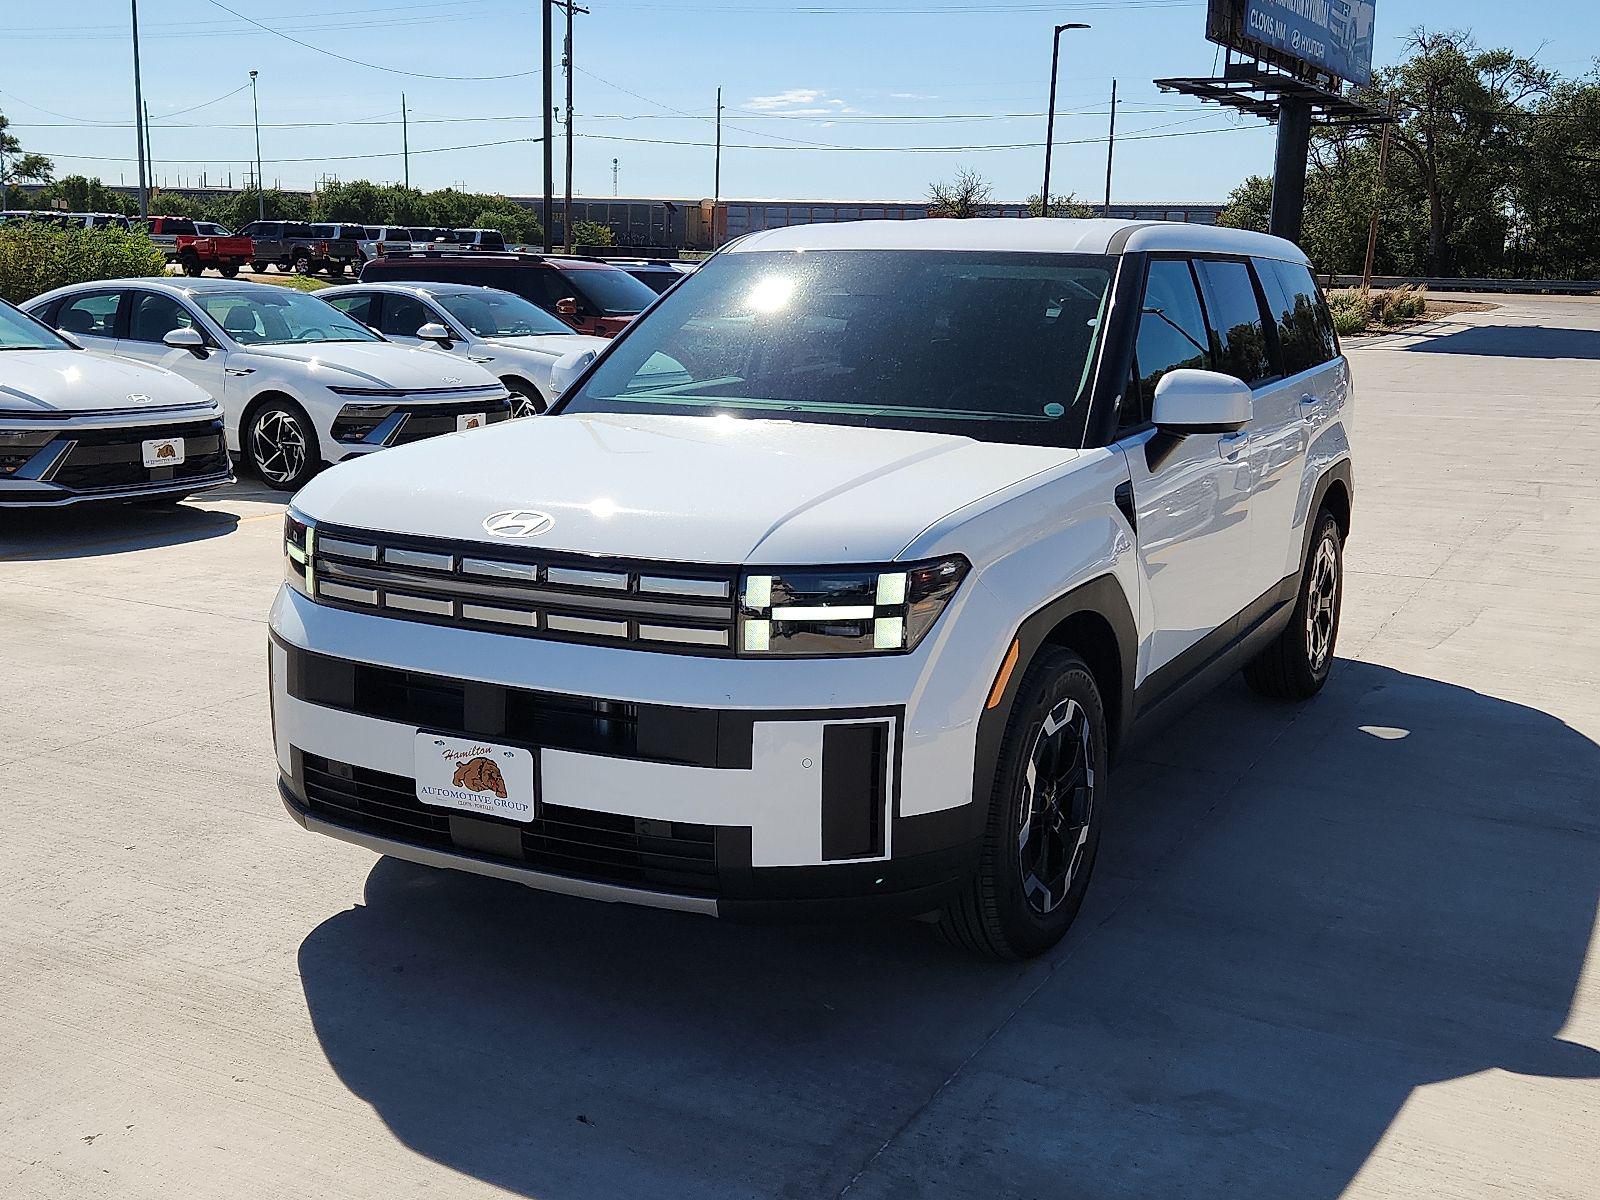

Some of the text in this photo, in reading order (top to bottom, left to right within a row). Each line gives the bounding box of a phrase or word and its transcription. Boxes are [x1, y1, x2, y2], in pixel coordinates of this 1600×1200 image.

[441, 745, 493, 761] Hamilton
[421, 786, 492, 805] AUTOMOTIVE
[493, 798, 529, 812] GROUP
